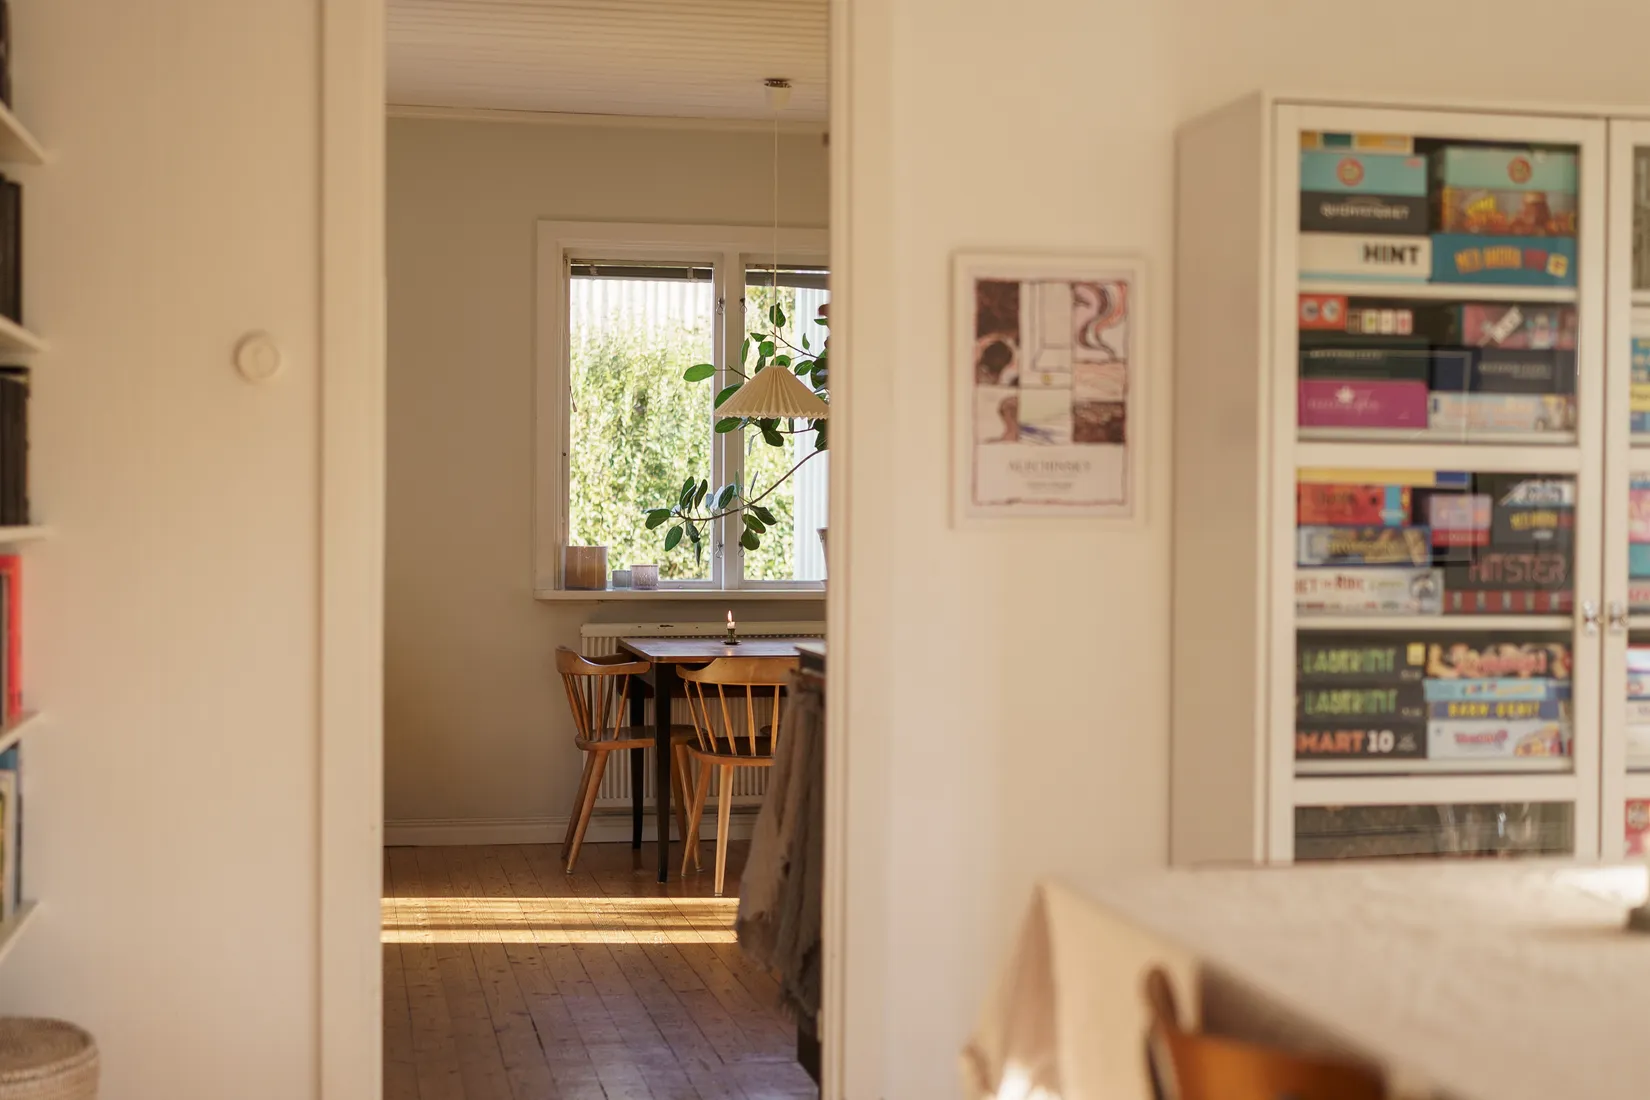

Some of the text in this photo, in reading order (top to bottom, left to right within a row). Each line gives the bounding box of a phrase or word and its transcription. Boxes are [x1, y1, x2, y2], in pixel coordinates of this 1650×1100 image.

[1362, 244, 1421, 264] HINT
[1469, 553, 1567, 583] HITSTER
[1366, 729, 1396, 754] 10
